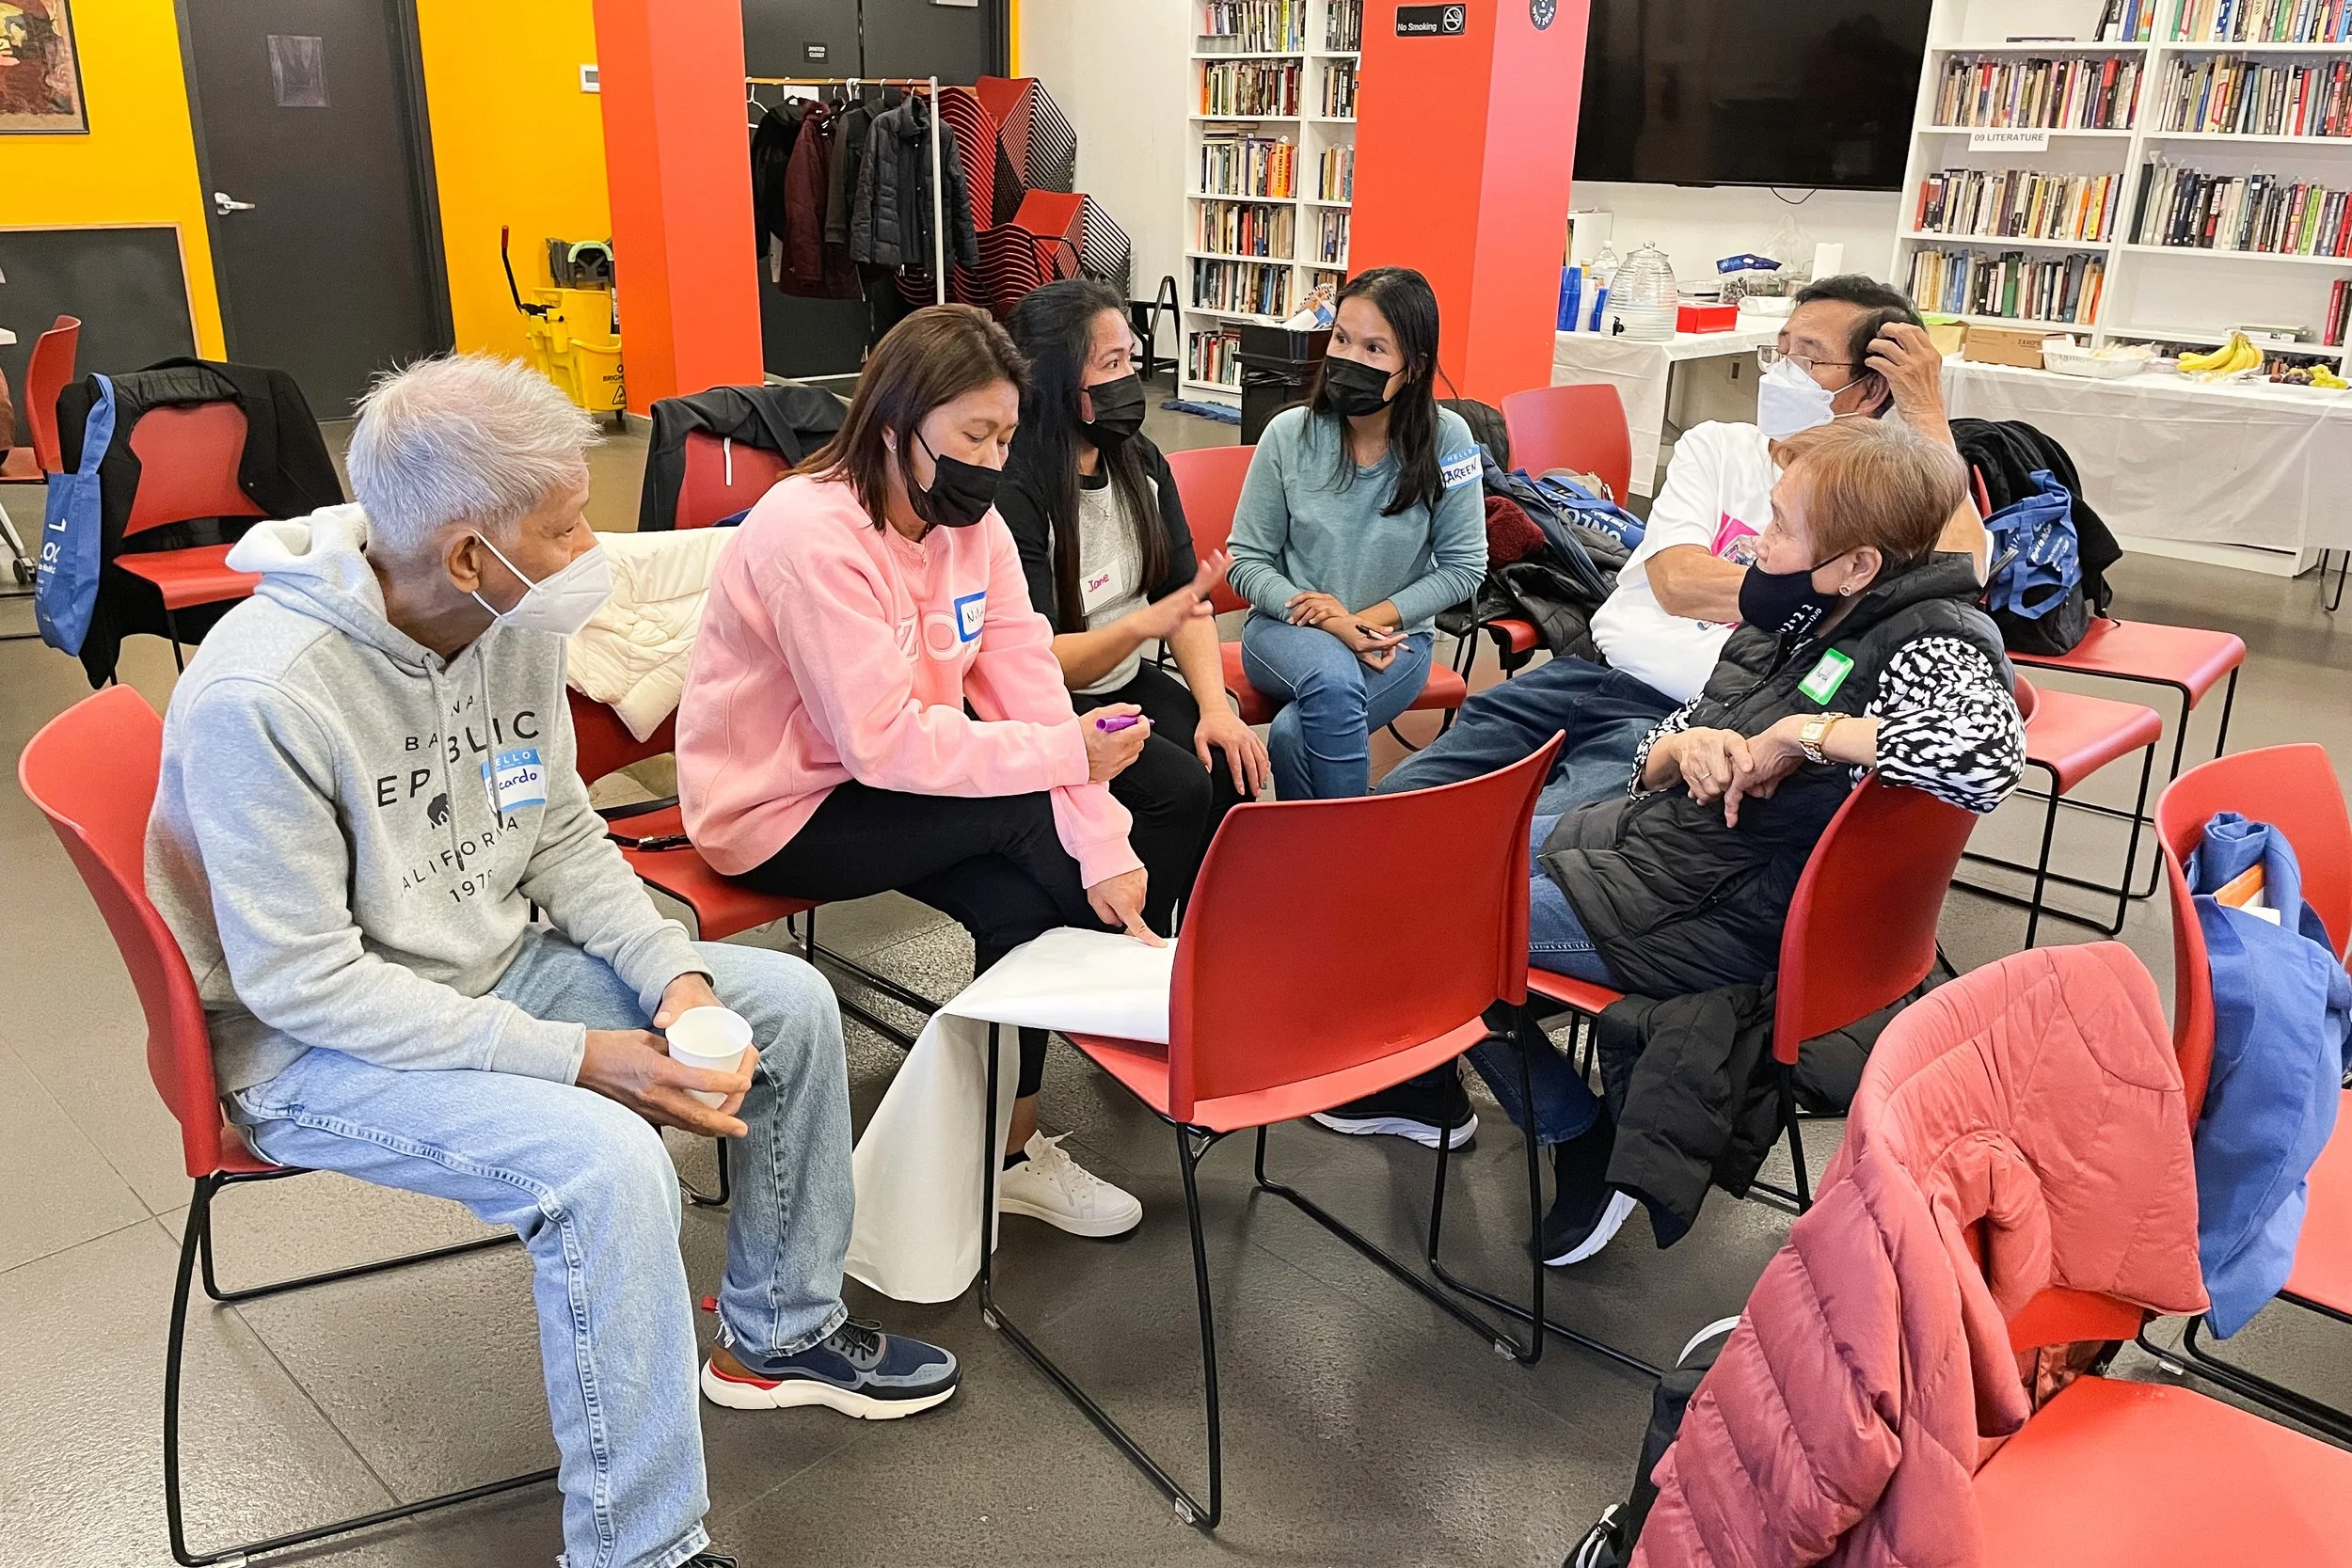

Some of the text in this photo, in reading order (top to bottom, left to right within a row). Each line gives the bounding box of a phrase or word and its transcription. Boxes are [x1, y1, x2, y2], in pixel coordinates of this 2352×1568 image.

[1397, 22, 1438, 32] No Smoking
[1974, 134, 2044, 142] 09 LITERATURE
[1446, 449, 1473, 462] HELLO
[495, 751, 532, 767] ELLO
